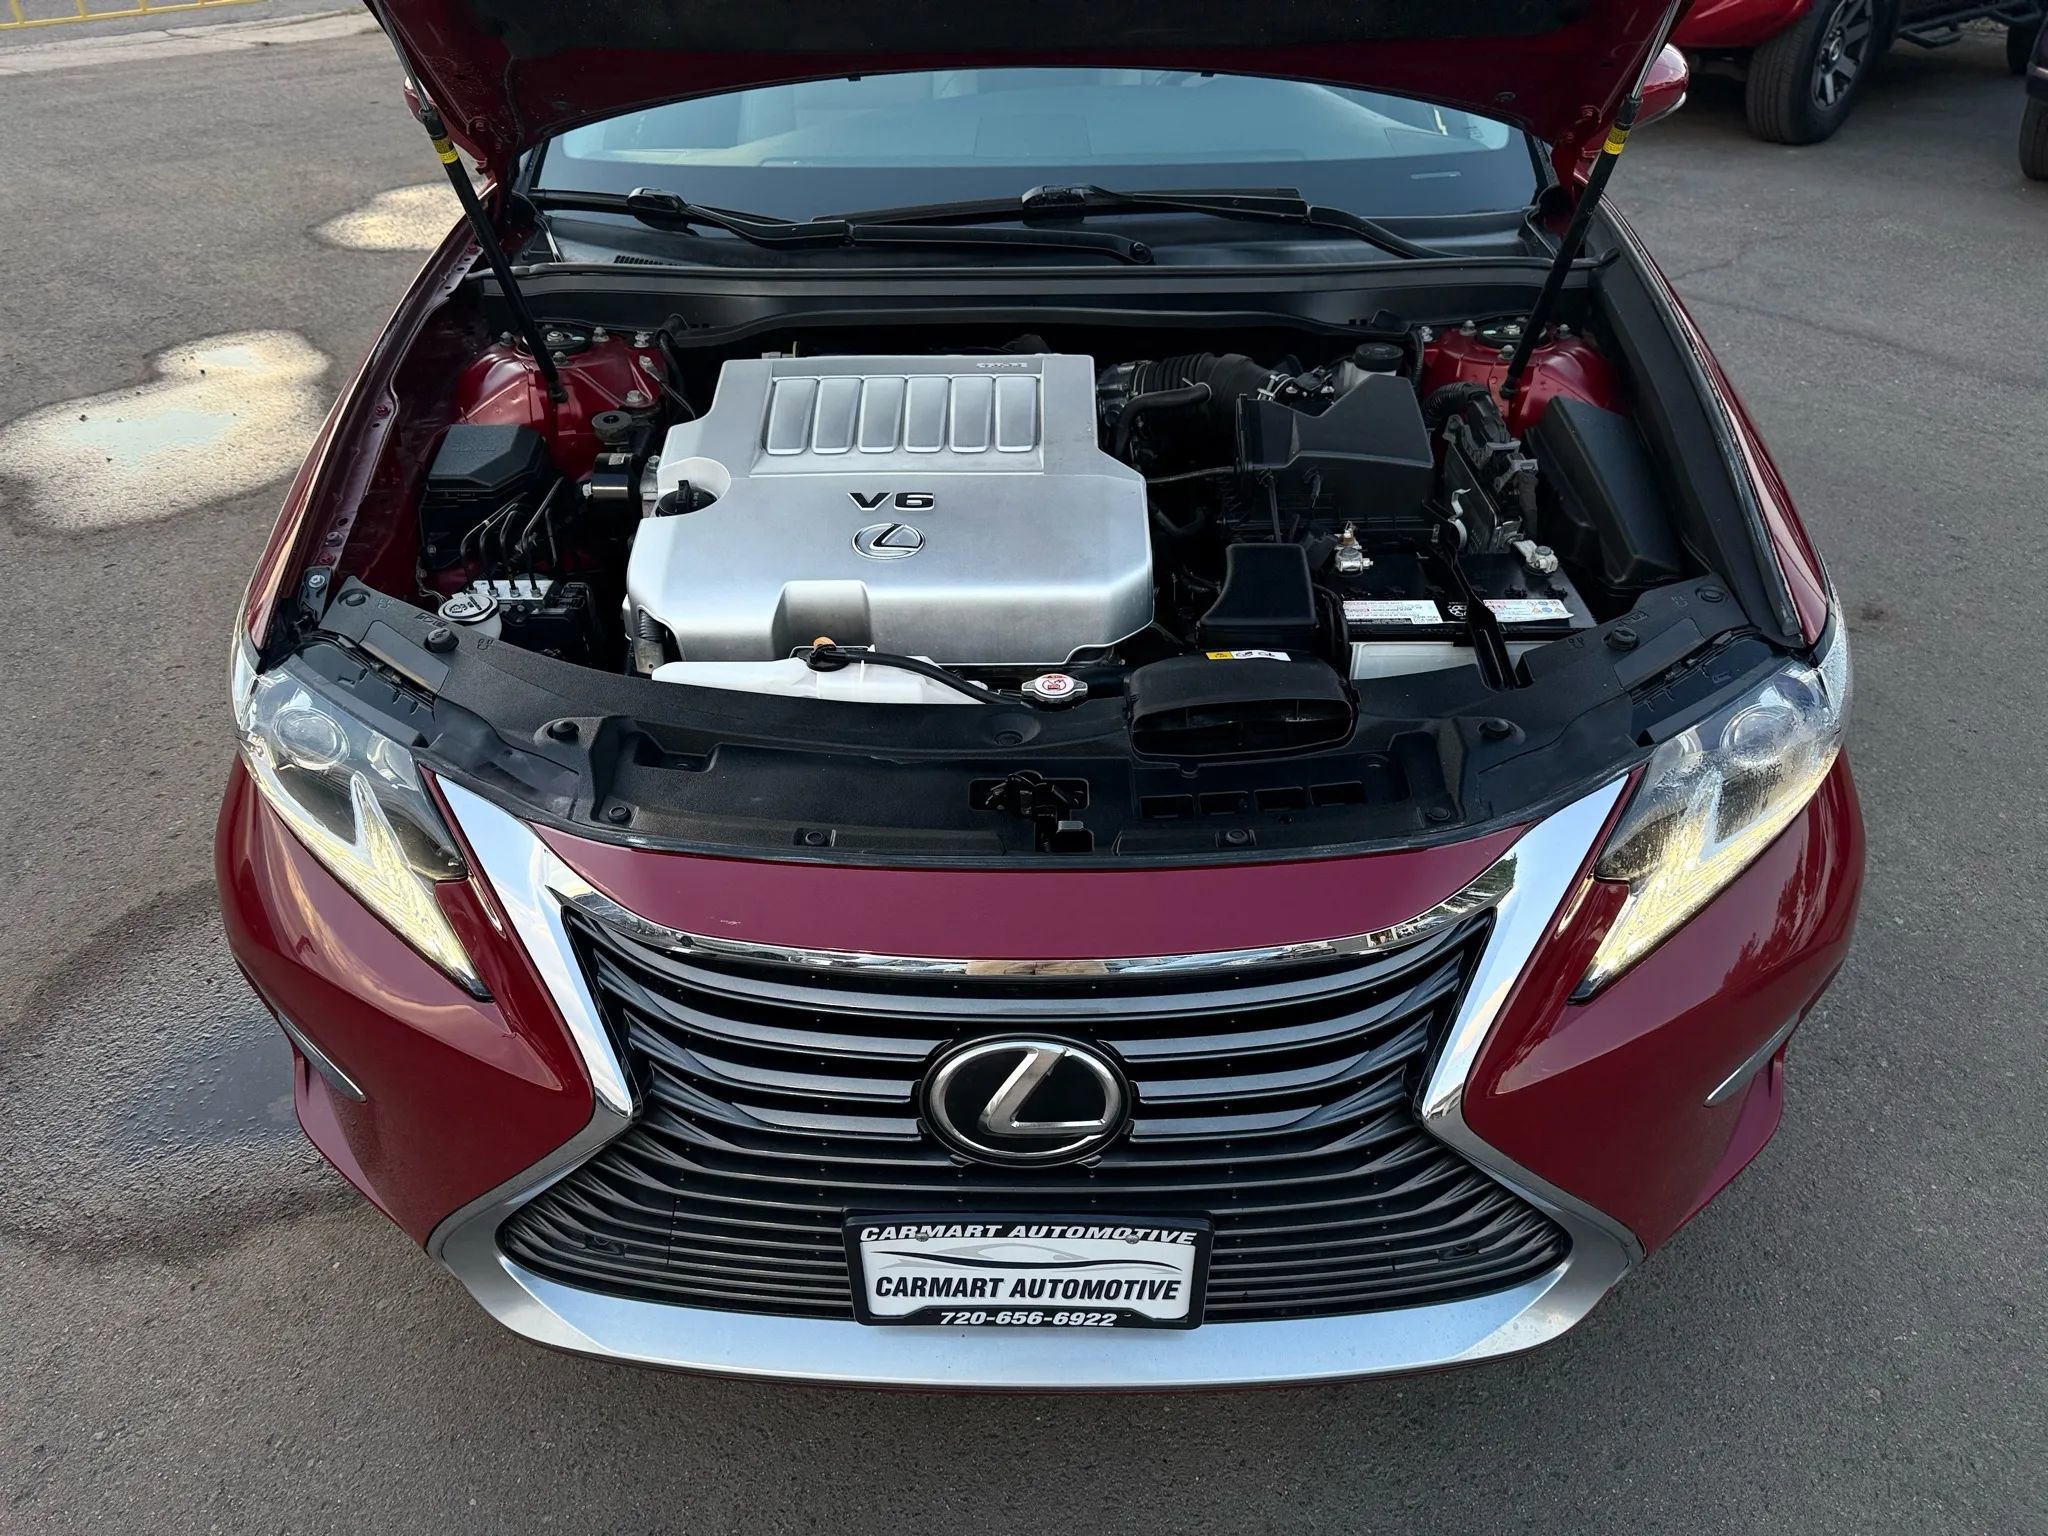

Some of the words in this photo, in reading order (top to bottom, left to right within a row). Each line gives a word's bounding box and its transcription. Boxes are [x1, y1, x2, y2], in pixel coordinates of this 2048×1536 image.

[848, 492, 934, 510] V6
[860, 1225, 1003, 1241] CARMART
[1007, 1225, 1197, 1245] AUTOMOTIVE
[875, 1276, 1005, 1298] CARMART
[1008, 1278, 1182, 1300] AUTOMOTIVE
[940, 1311, 1118, 1327] 720-656-6922
